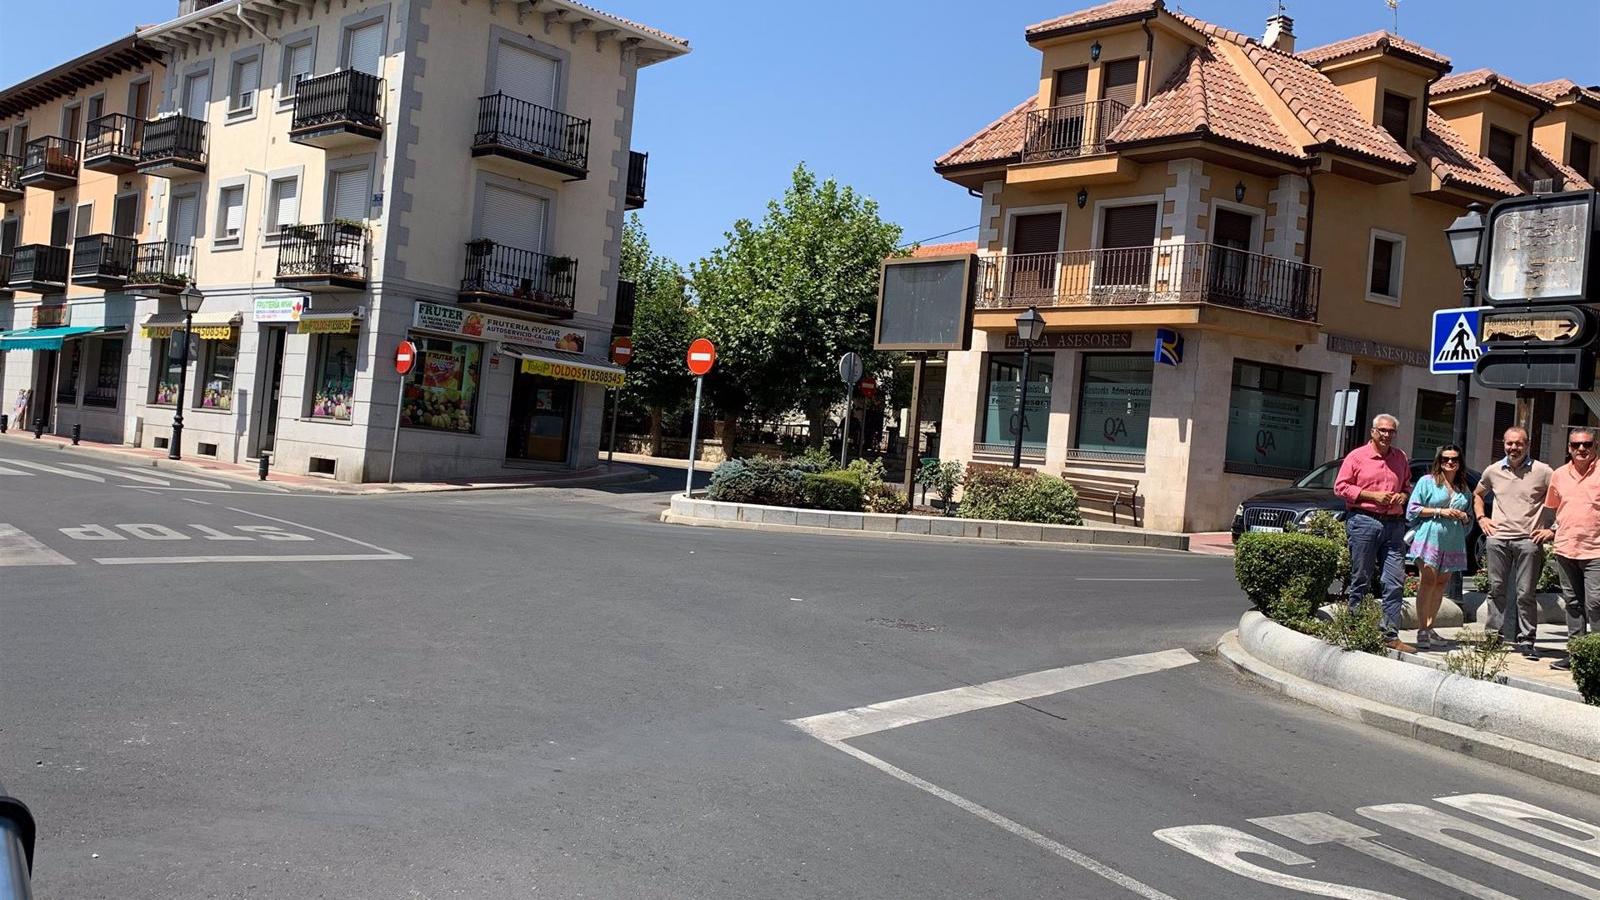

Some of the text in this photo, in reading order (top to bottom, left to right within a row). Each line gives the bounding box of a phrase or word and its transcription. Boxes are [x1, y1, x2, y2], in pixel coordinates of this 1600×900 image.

[418, 303, 463, 321] FRUTER
[487, 318, 560, 337] FRUTERIA AYSAR
[1057, 333, 1129, 347] ASESORES
[1374, 344, 1430, 365] ASESORES
[551, 364, 581, 378] TOLDOS
[581, 368, 622, 385] 918508545
[58, 523, 315, 541] STOP
